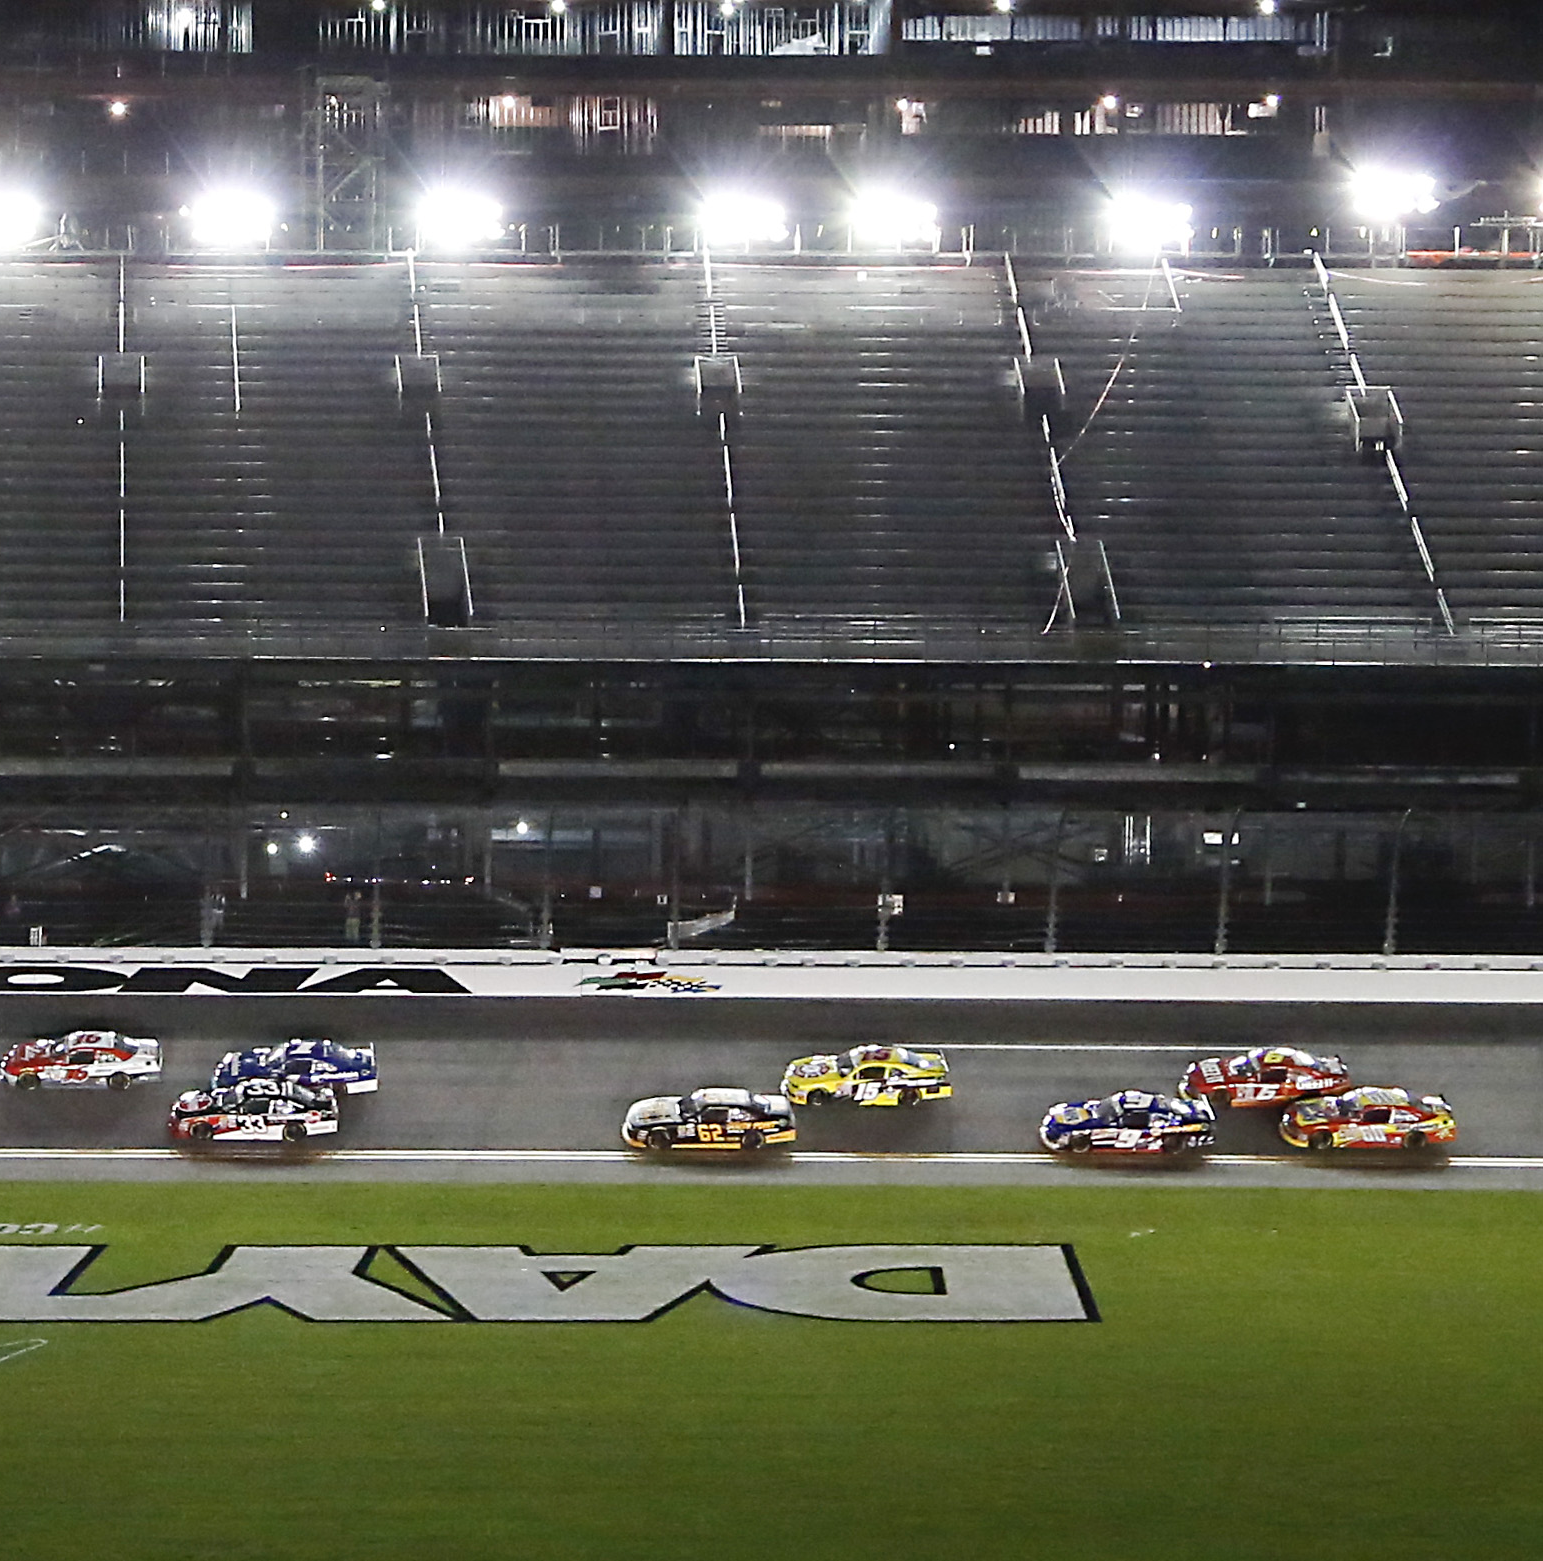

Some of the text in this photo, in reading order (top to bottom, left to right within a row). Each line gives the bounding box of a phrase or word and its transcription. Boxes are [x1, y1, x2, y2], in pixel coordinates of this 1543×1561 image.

[247, 1080, 280, 1096] 33
[854, 1082, 881, 1101] 15
[238, 1115, 267, 1134] 33
[697, 1123, 725, 1142] 62
[1114, 1128, 1142, 1148] 9
